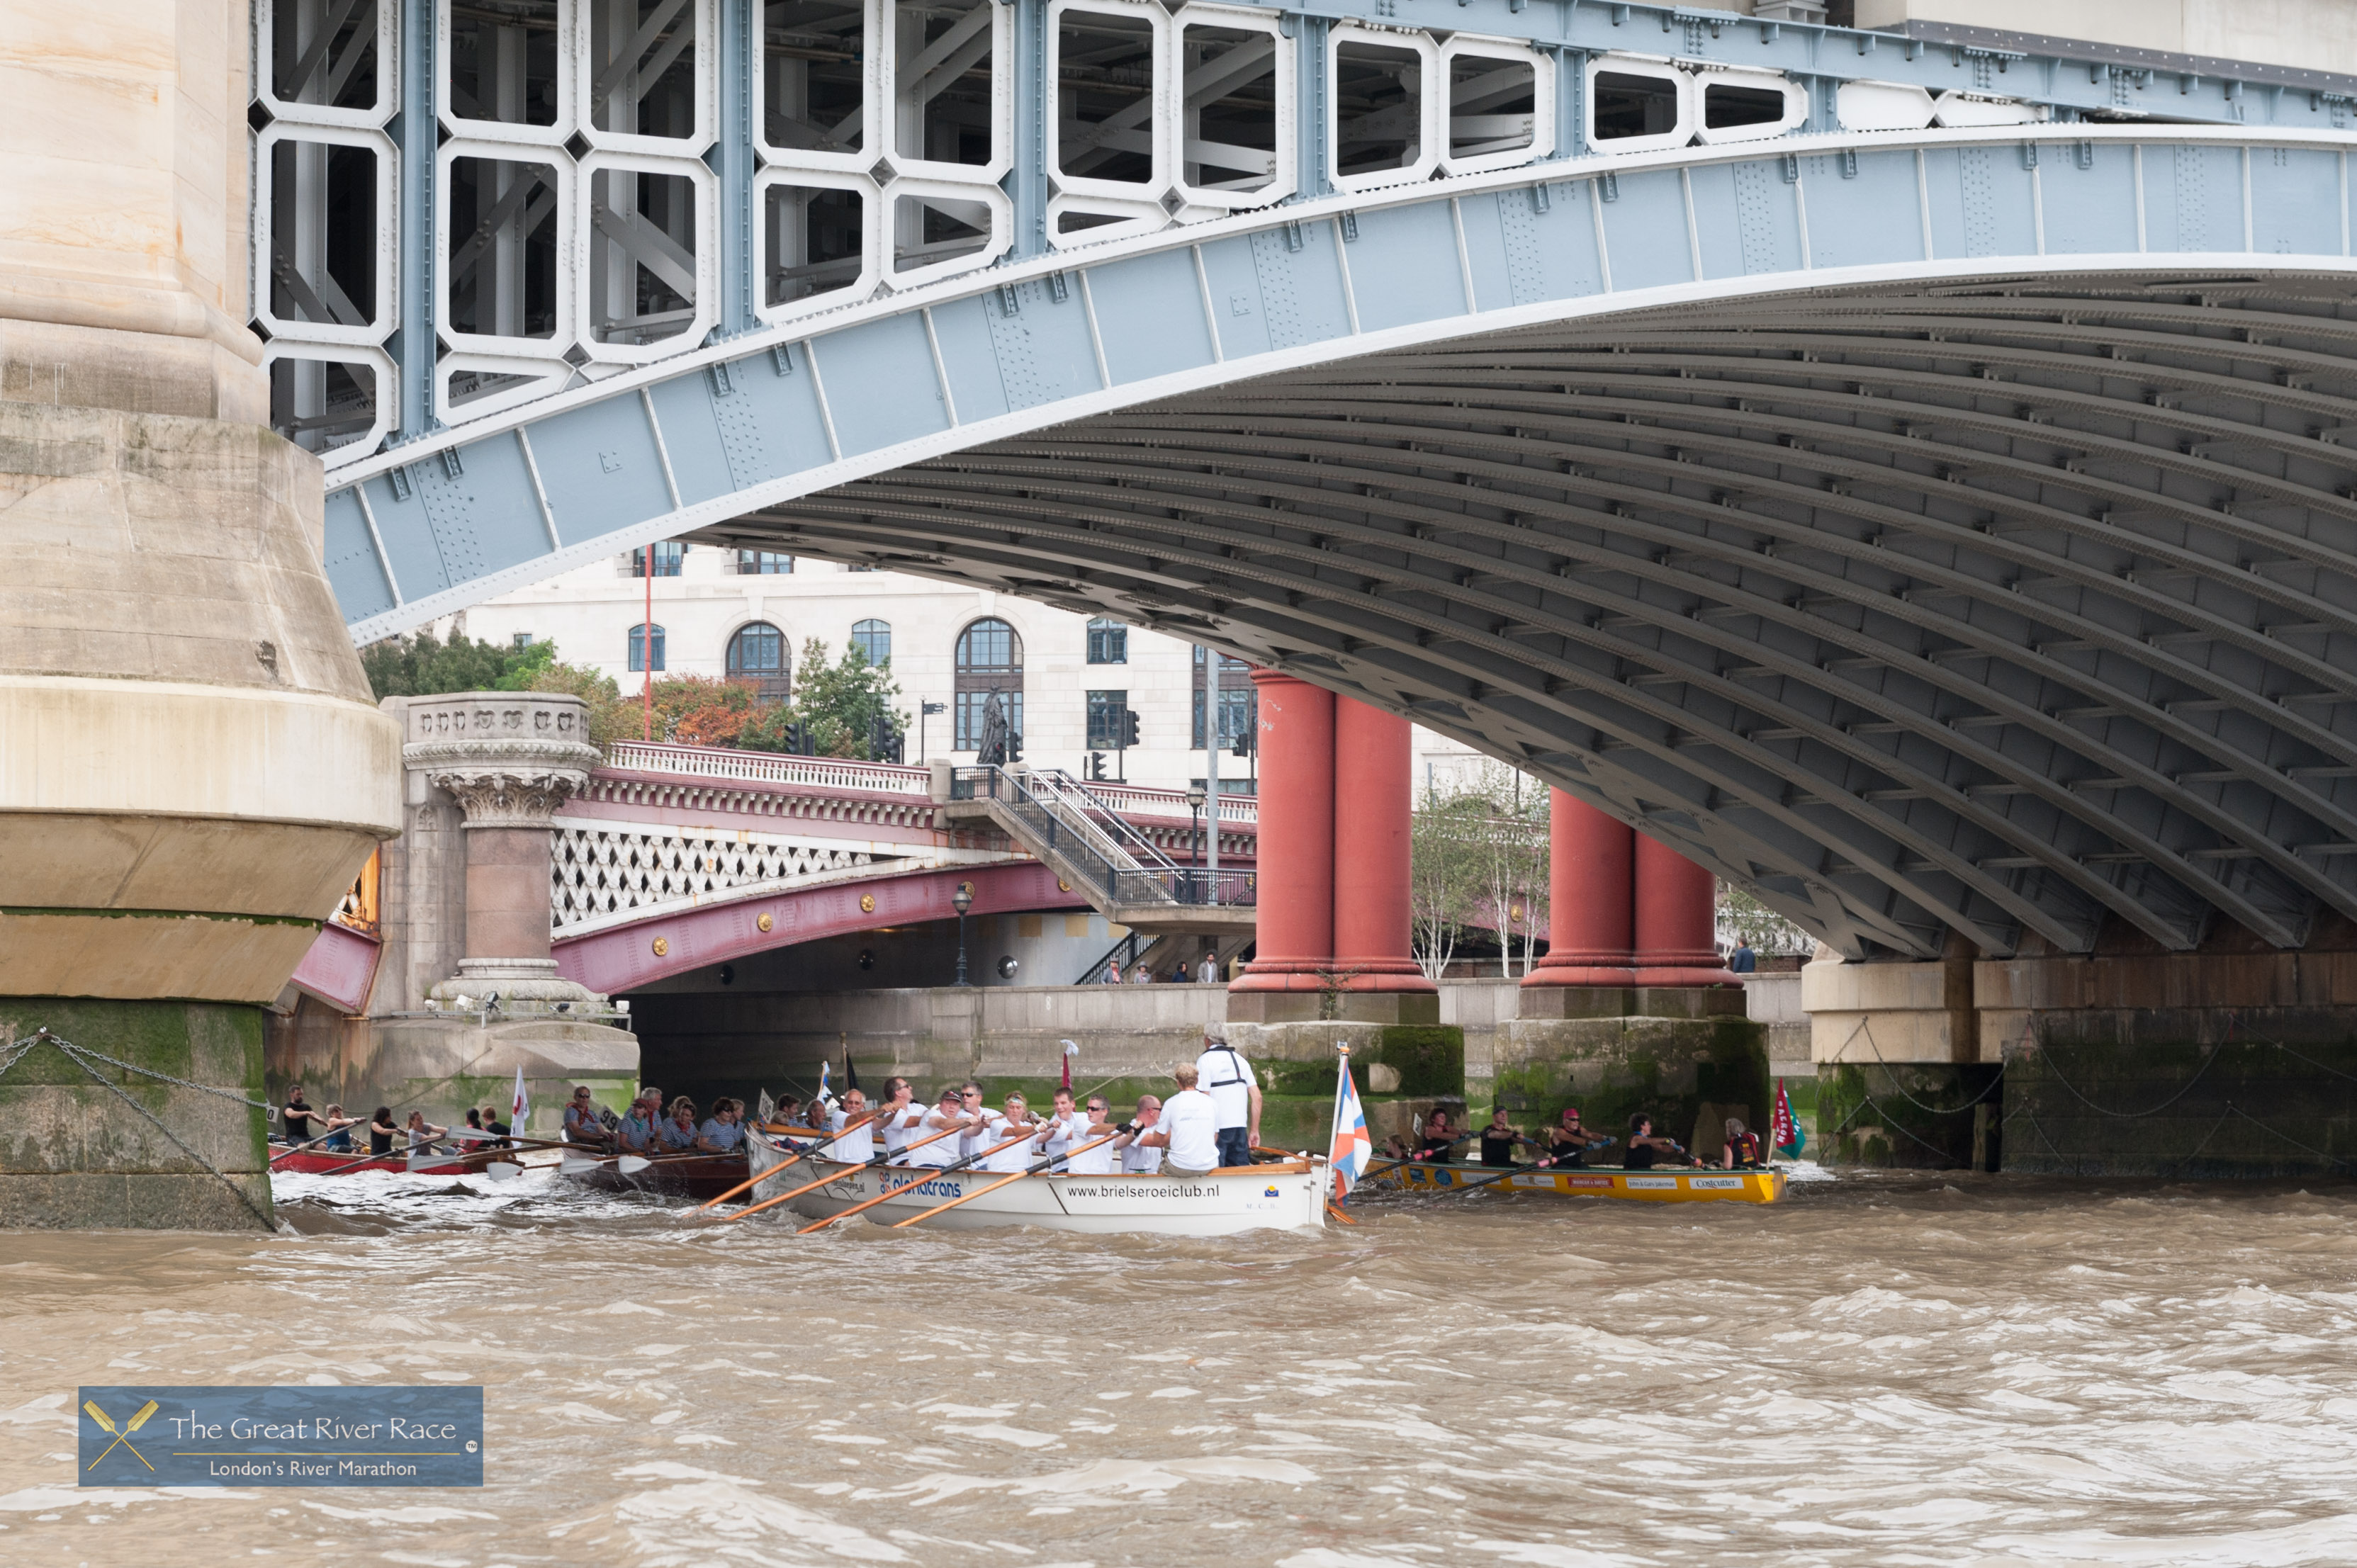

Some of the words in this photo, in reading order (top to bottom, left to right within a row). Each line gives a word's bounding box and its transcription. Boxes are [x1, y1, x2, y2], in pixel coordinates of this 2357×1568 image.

[600, 1110, 618, 1130] 99
[1696, 1179, 1736, 1188] Costcutter
[1067, 1184, 1220, 1197] www.brielseroeiclub.nl
